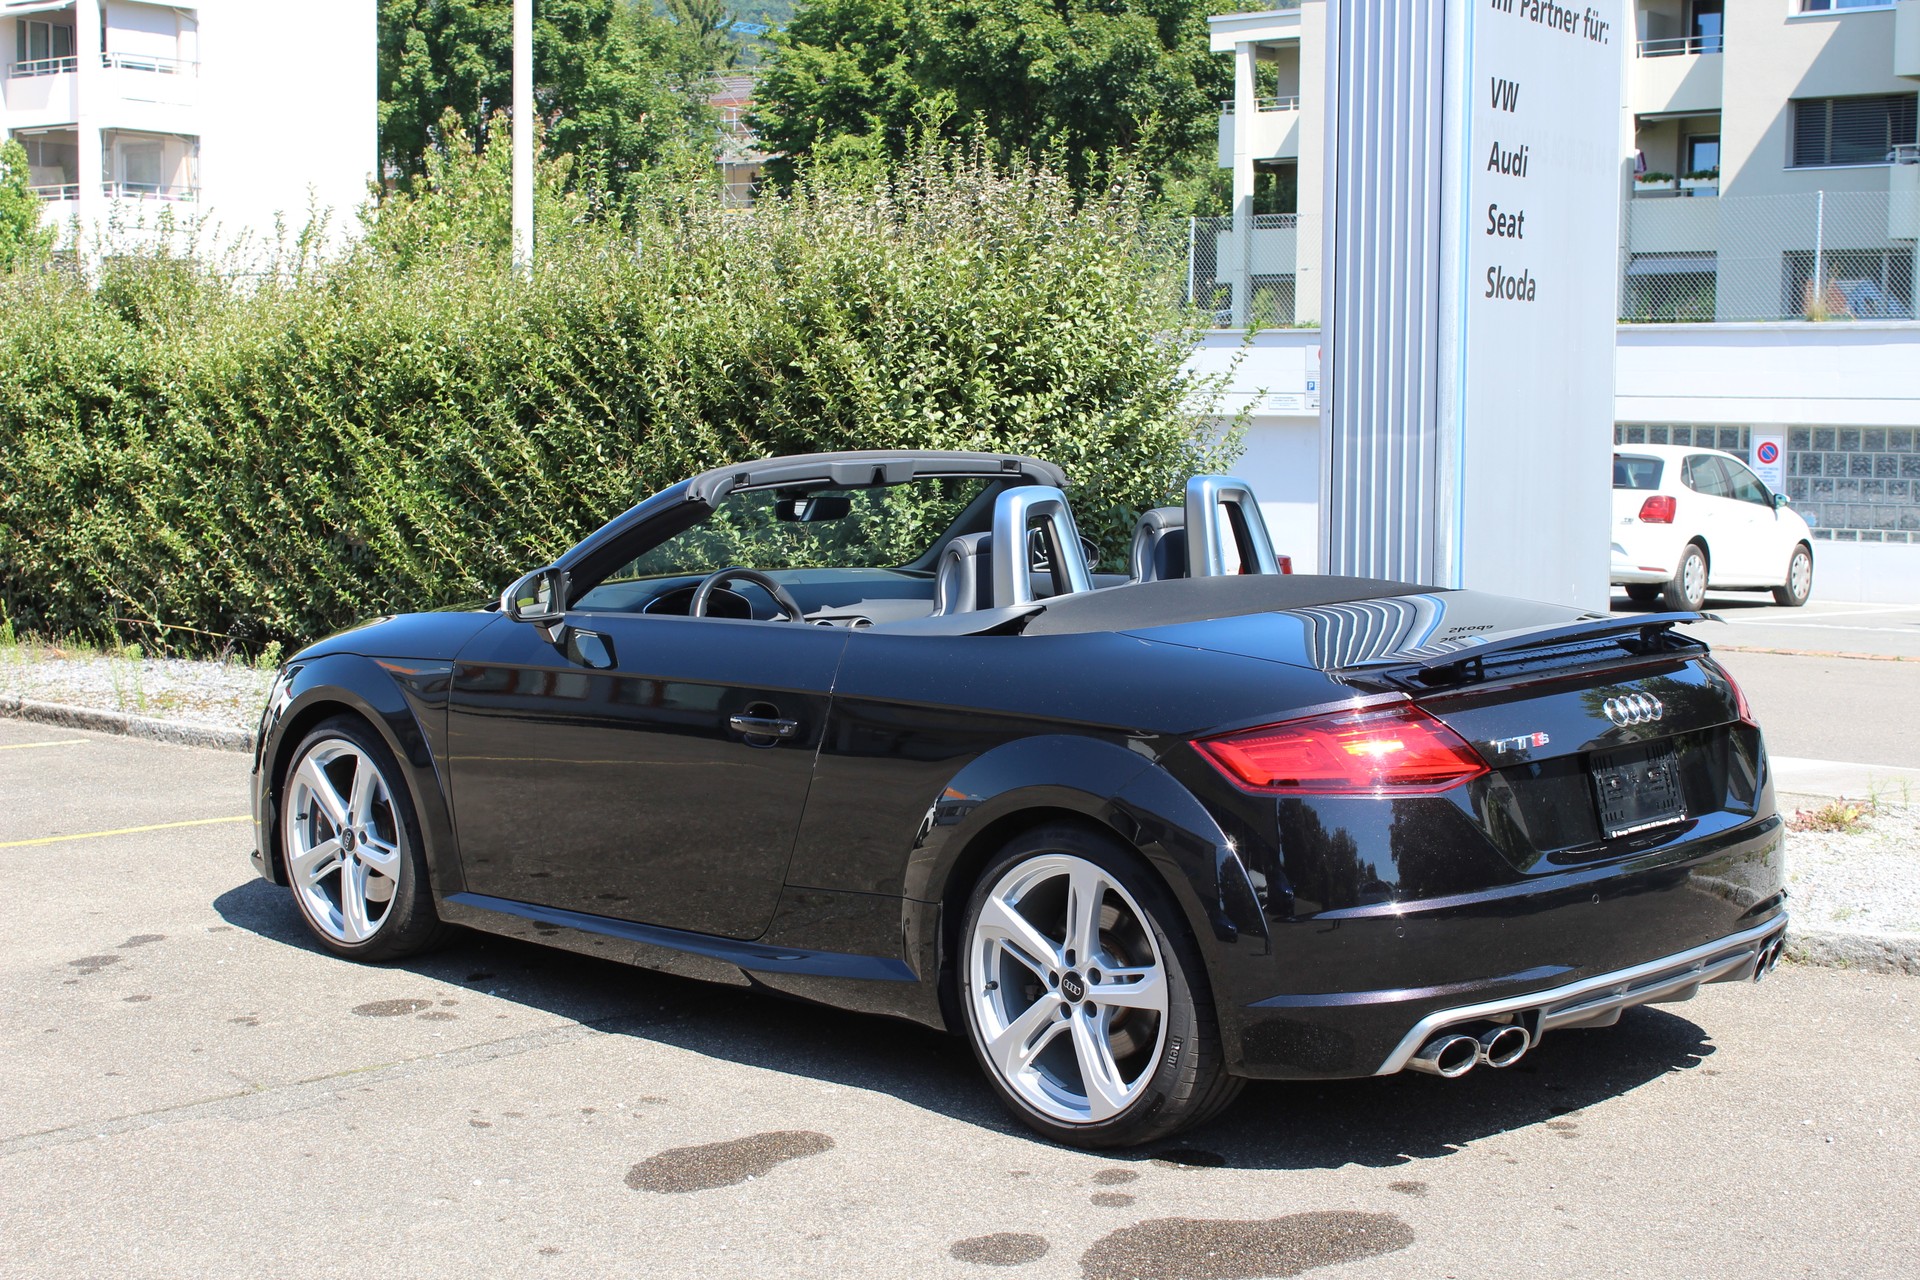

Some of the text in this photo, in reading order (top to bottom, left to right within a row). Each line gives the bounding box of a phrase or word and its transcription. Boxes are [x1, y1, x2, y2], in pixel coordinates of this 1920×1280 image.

[1584, 7, 1610, 45] für:
[1491, 76, 1520, 113] VW
[1487, 141, 1529, 178] Audi
[1486, 203, 1525, 240] Seat
[1485, 265, 1536, 302] Skoda
[1490, 731, 1550, 754] TTS
